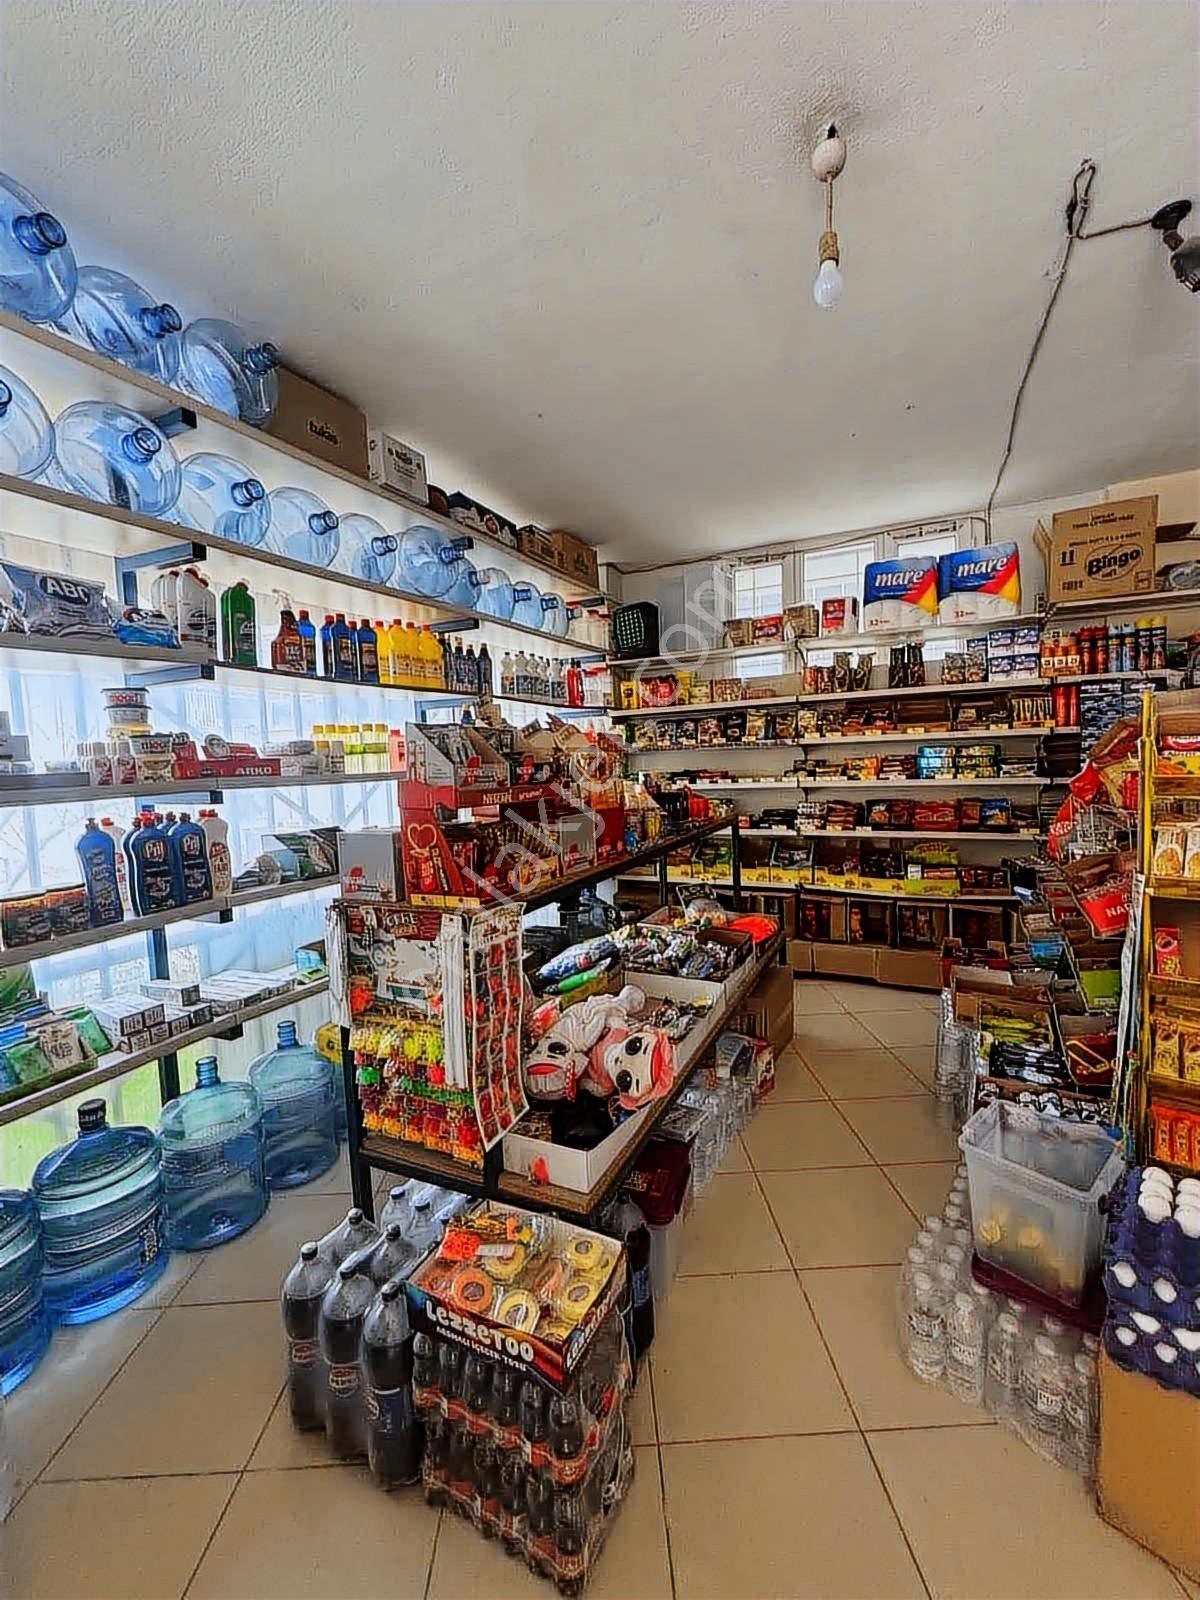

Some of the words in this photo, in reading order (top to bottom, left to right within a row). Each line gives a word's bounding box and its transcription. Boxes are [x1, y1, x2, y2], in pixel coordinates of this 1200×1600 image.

[957, 557, 1008, 577] mare
[1087, 549, 1141, 577] Bingo
[874, 570, 925, 587] mare
